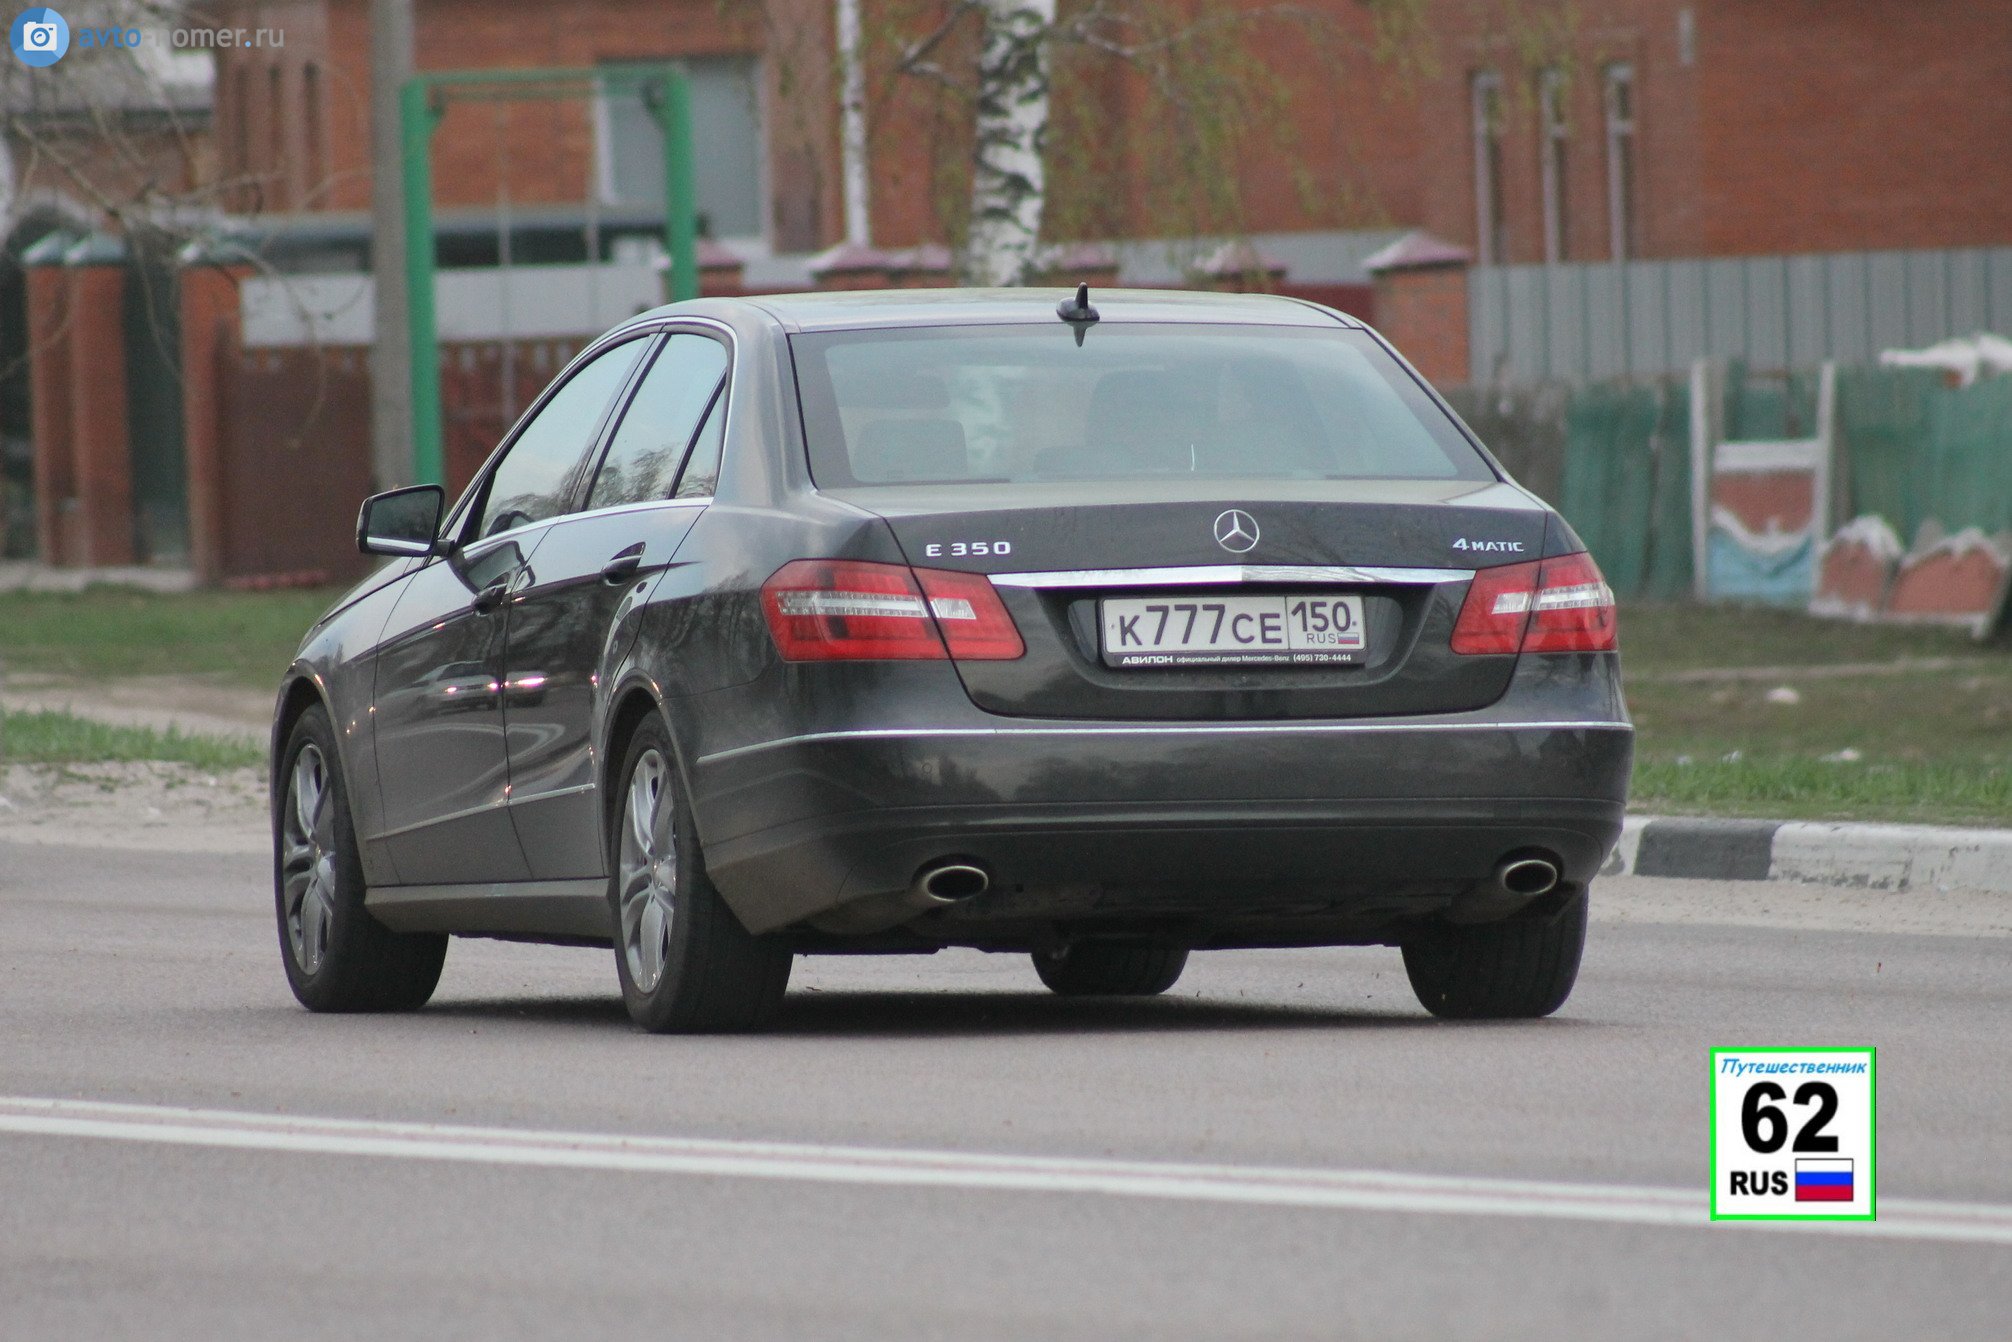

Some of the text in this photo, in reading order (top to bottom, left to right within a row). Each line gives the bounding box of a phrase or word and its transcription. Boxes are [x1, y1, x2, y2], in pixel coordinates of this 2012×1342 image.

[925, 541, 1011, 557] E 350
[1452, 537, 1525, 552] 4MATIC
[1291, 601, 1351, 632] 150
[1306, 632, 1336, 644] RUS
[1122, 655, 1173, 664] АВИЛОН
[1293, 653, 1313, 662] (495)
[1314, 653, 1352, 662] 730-4444
